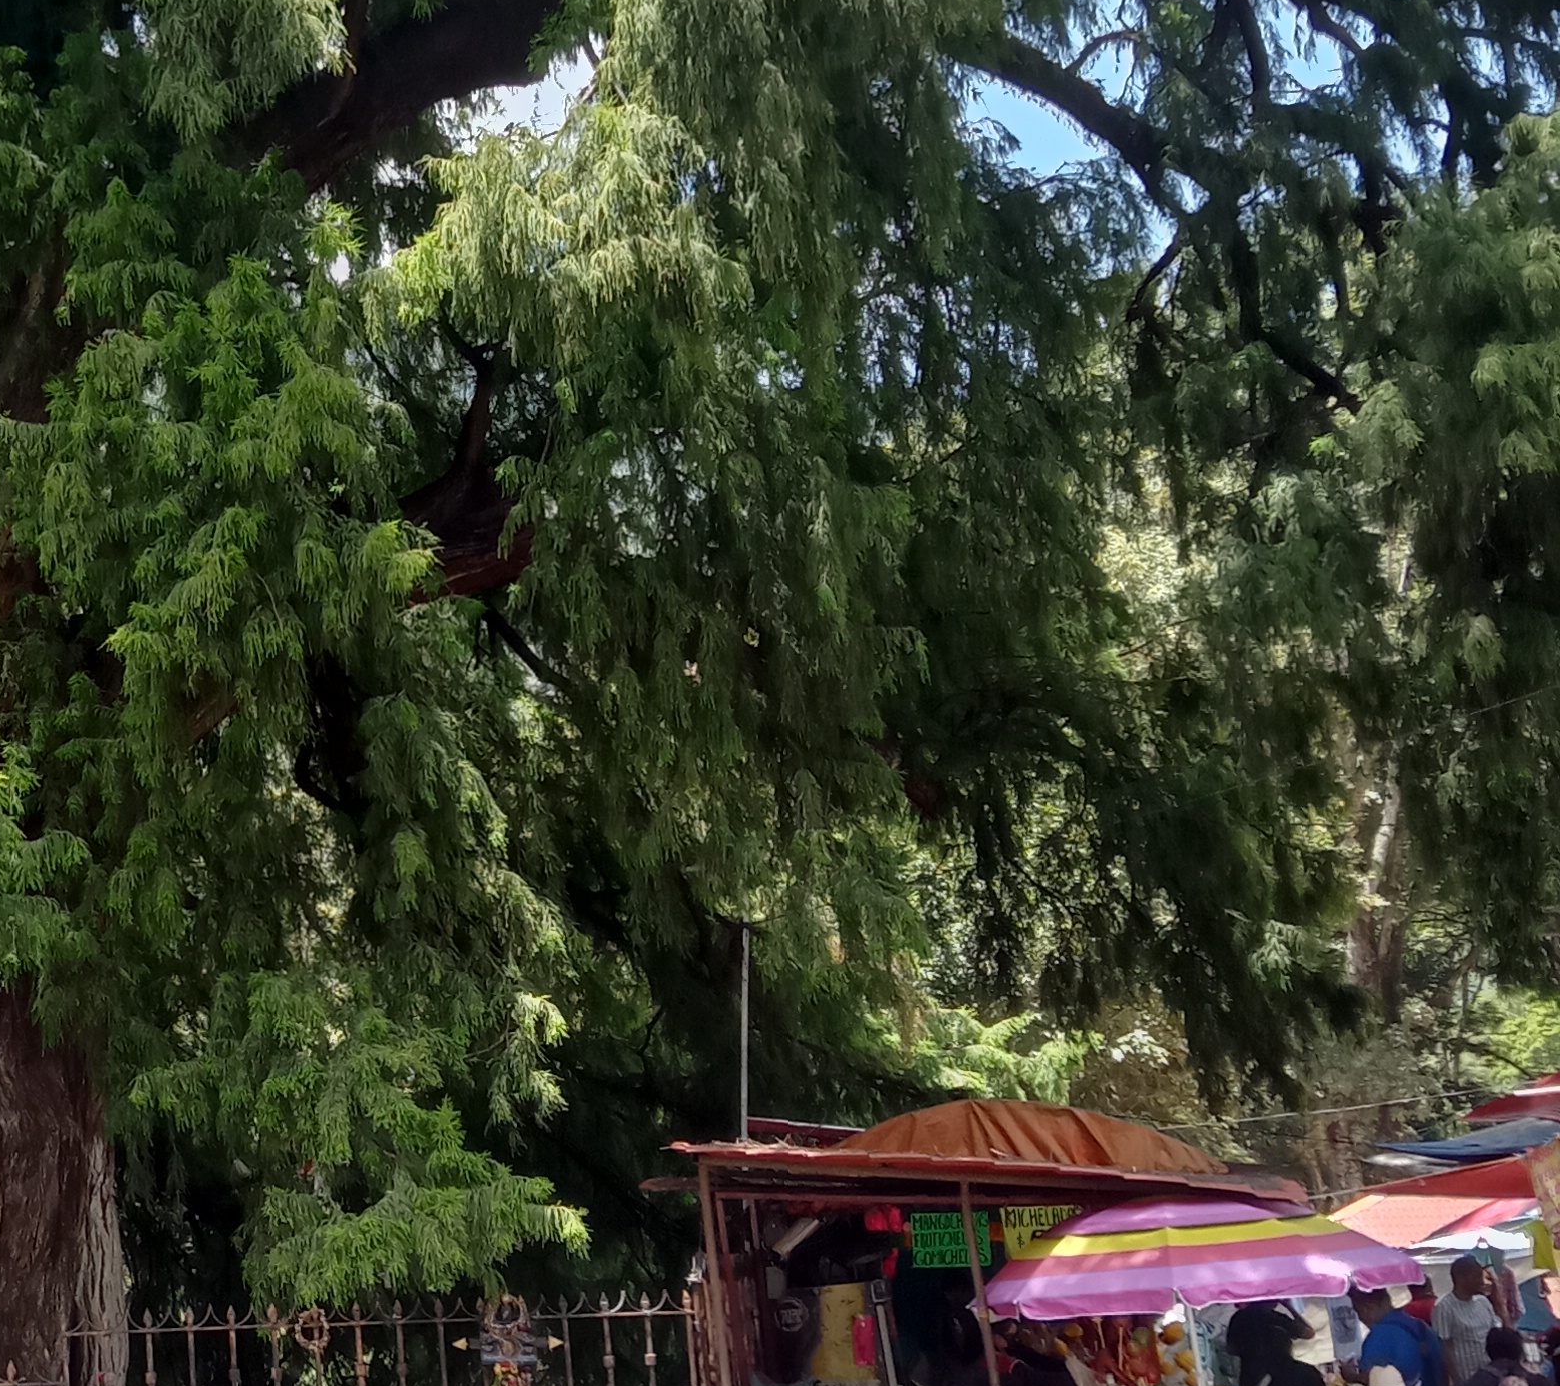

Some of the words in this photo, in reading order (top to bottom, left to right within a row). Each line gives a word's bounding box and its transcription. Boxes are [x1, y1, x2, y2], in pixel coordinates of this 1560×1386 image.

[912, 1212, 988, 1231] MANGOCHAS
[913, 1231, 984, 1248] FRUTICHELS
[914, 1249, 989, 1266] GOMICHELS
